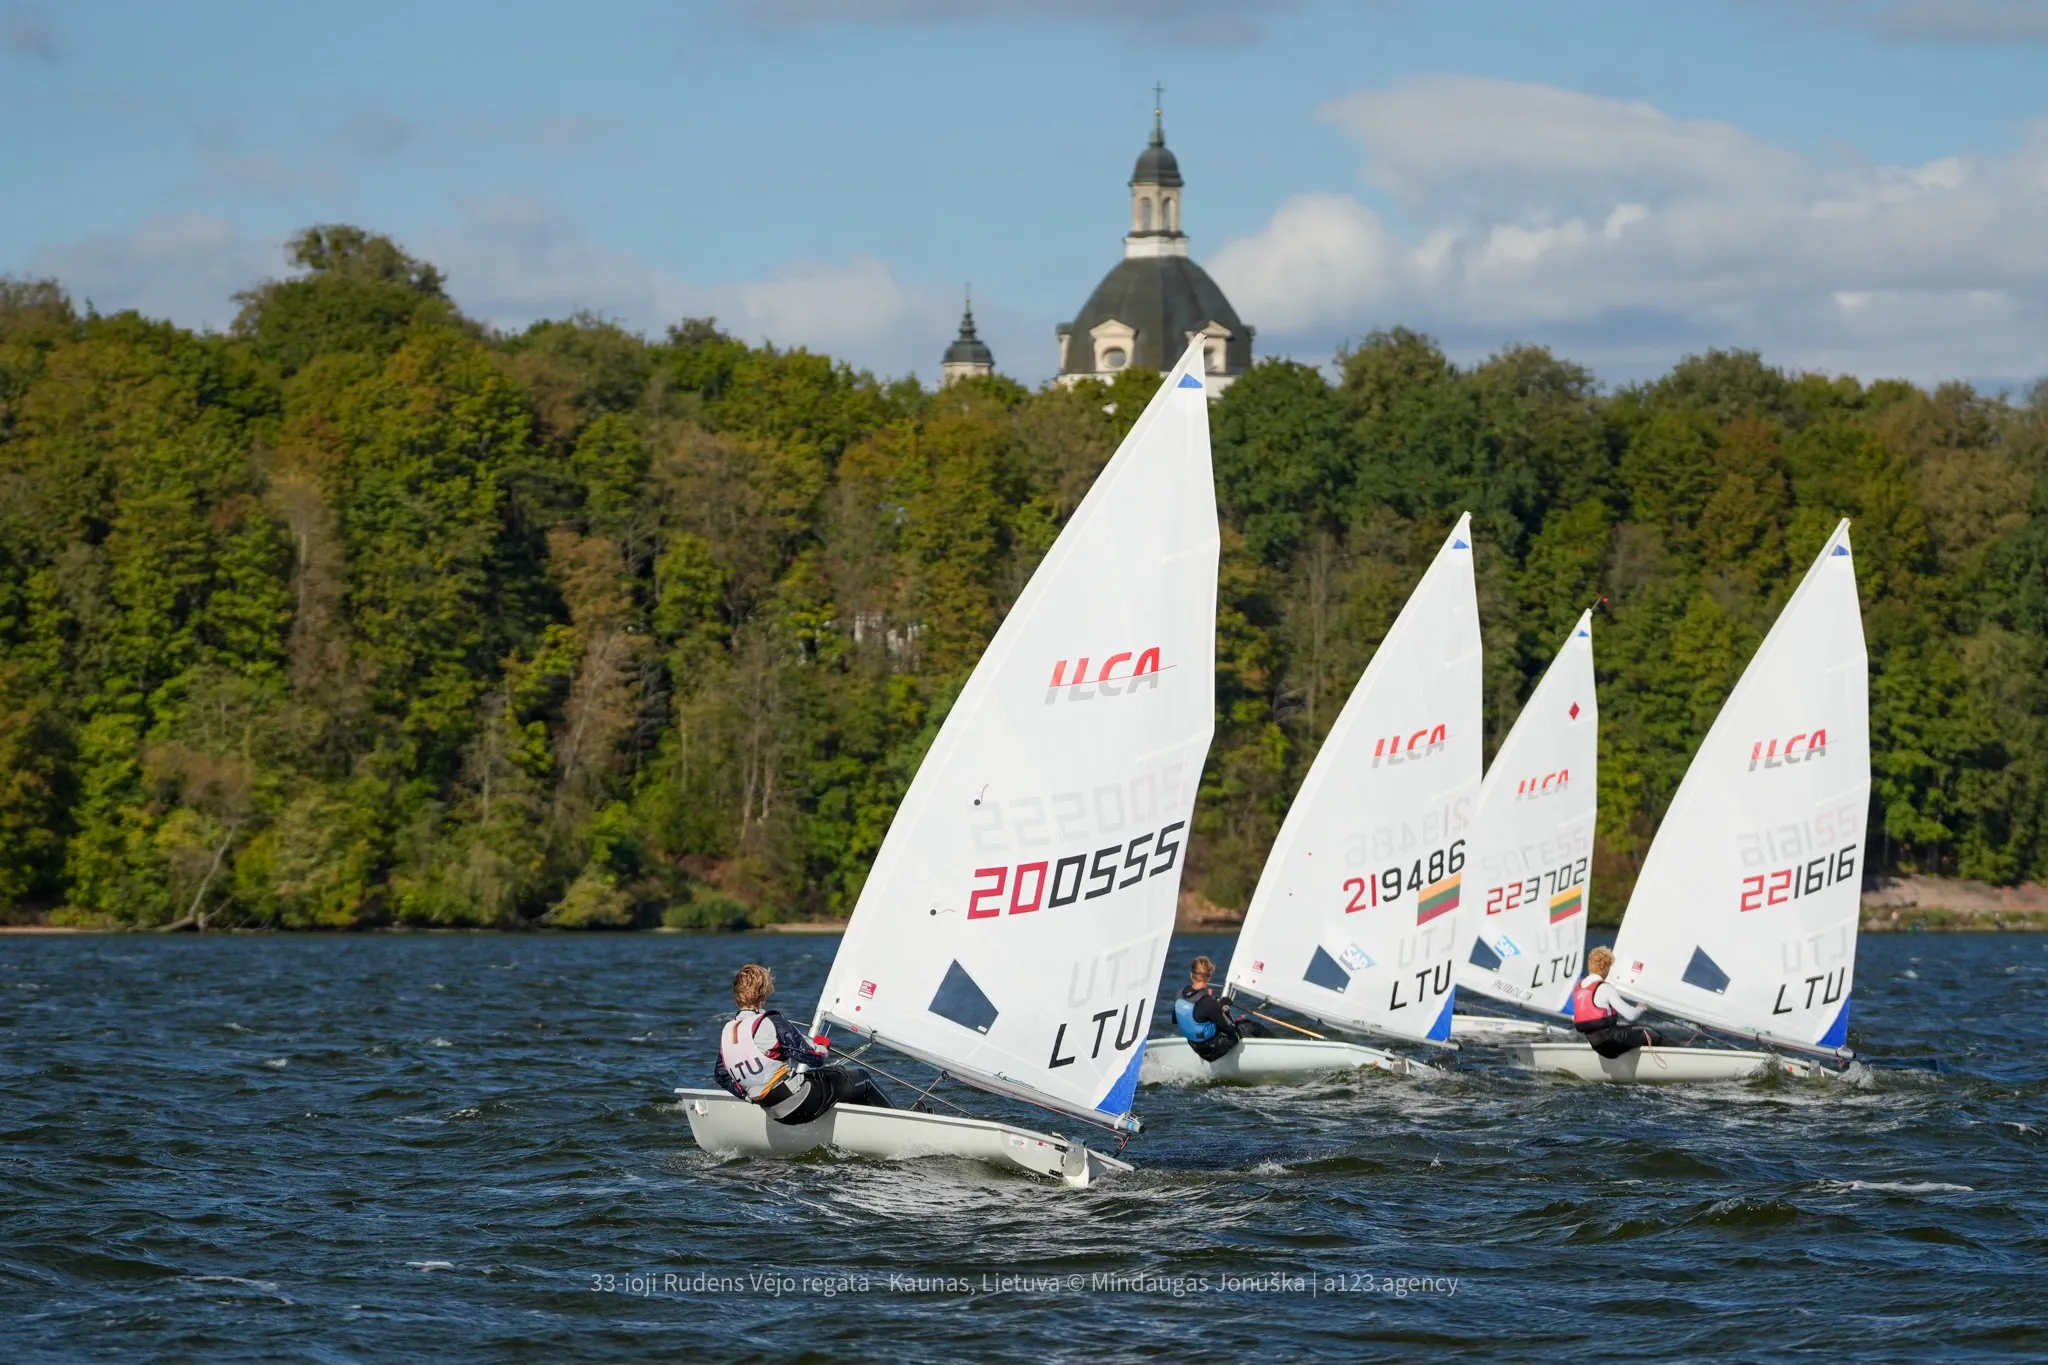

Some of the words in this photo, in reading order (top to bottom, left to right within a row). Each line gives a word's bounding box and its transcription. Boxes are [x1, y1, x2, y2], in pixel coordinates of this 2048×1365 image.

[1043, 647, 1161, 706] ILCA
[1371, 723, 1446, 769] ILCA
[1747, 728, 1827, 772] ILCA
[1515, 768, 1569, 801] ILCA
[966, 820, 1186, 920] 200555
[1342, 838, 1466, 915] 219486
[1486, 856, 1588, 916] 223702
[1740, 844, 1858, 913] 221616
[1389, 960, 1453, 1012] LTU
[1531, 951, 1578, 989] LTU
[1772, 966, 1846, 1016] LTU
[1048, 998, 1147, 1070] LTU
